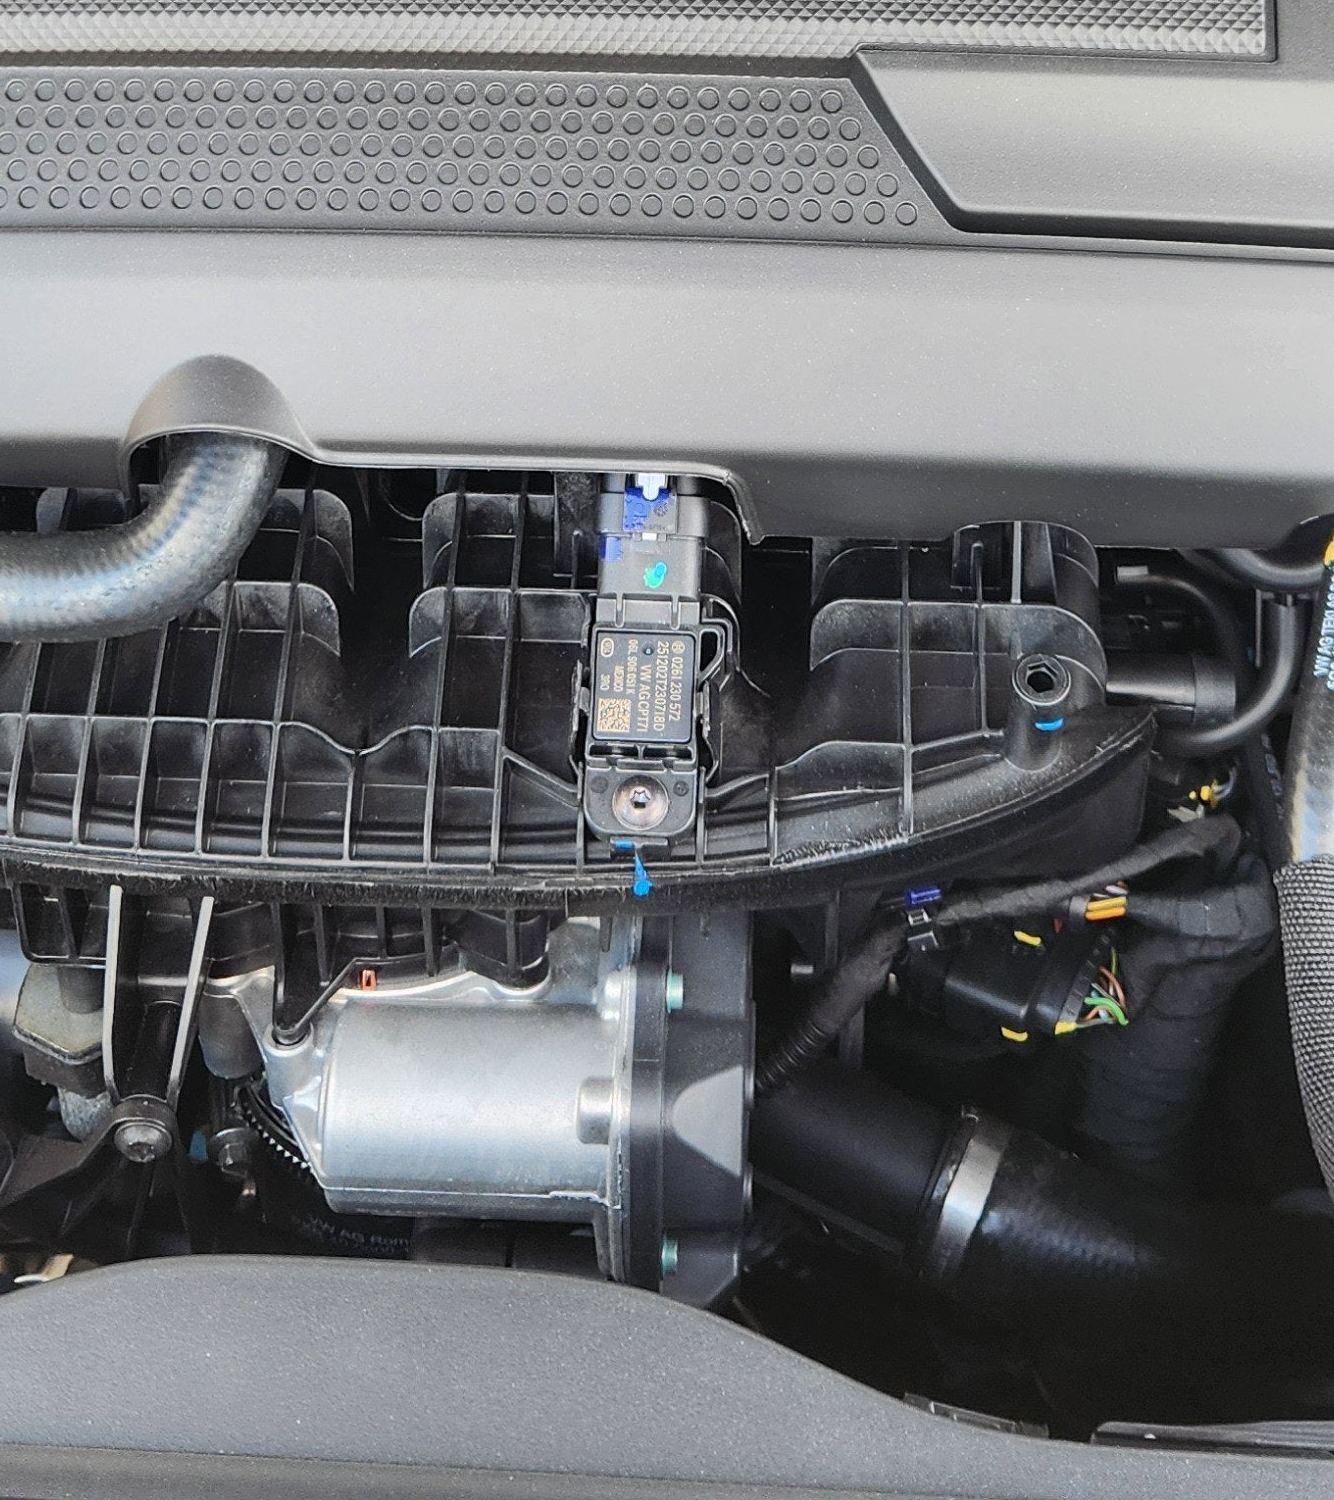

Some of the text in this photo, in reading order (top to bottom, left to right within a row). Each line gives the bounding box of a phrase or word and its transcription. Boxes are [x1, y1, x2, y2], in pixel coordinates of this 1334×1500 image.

[1317, 635, 1334, 657] AG
[639, 664, 652, 683] VW
[1313, 654, 1332, 678] VW
[638, 683, 651, 700] AG
[669, 681, 683, 701] 230
[668, 702, 682, 722] 572
